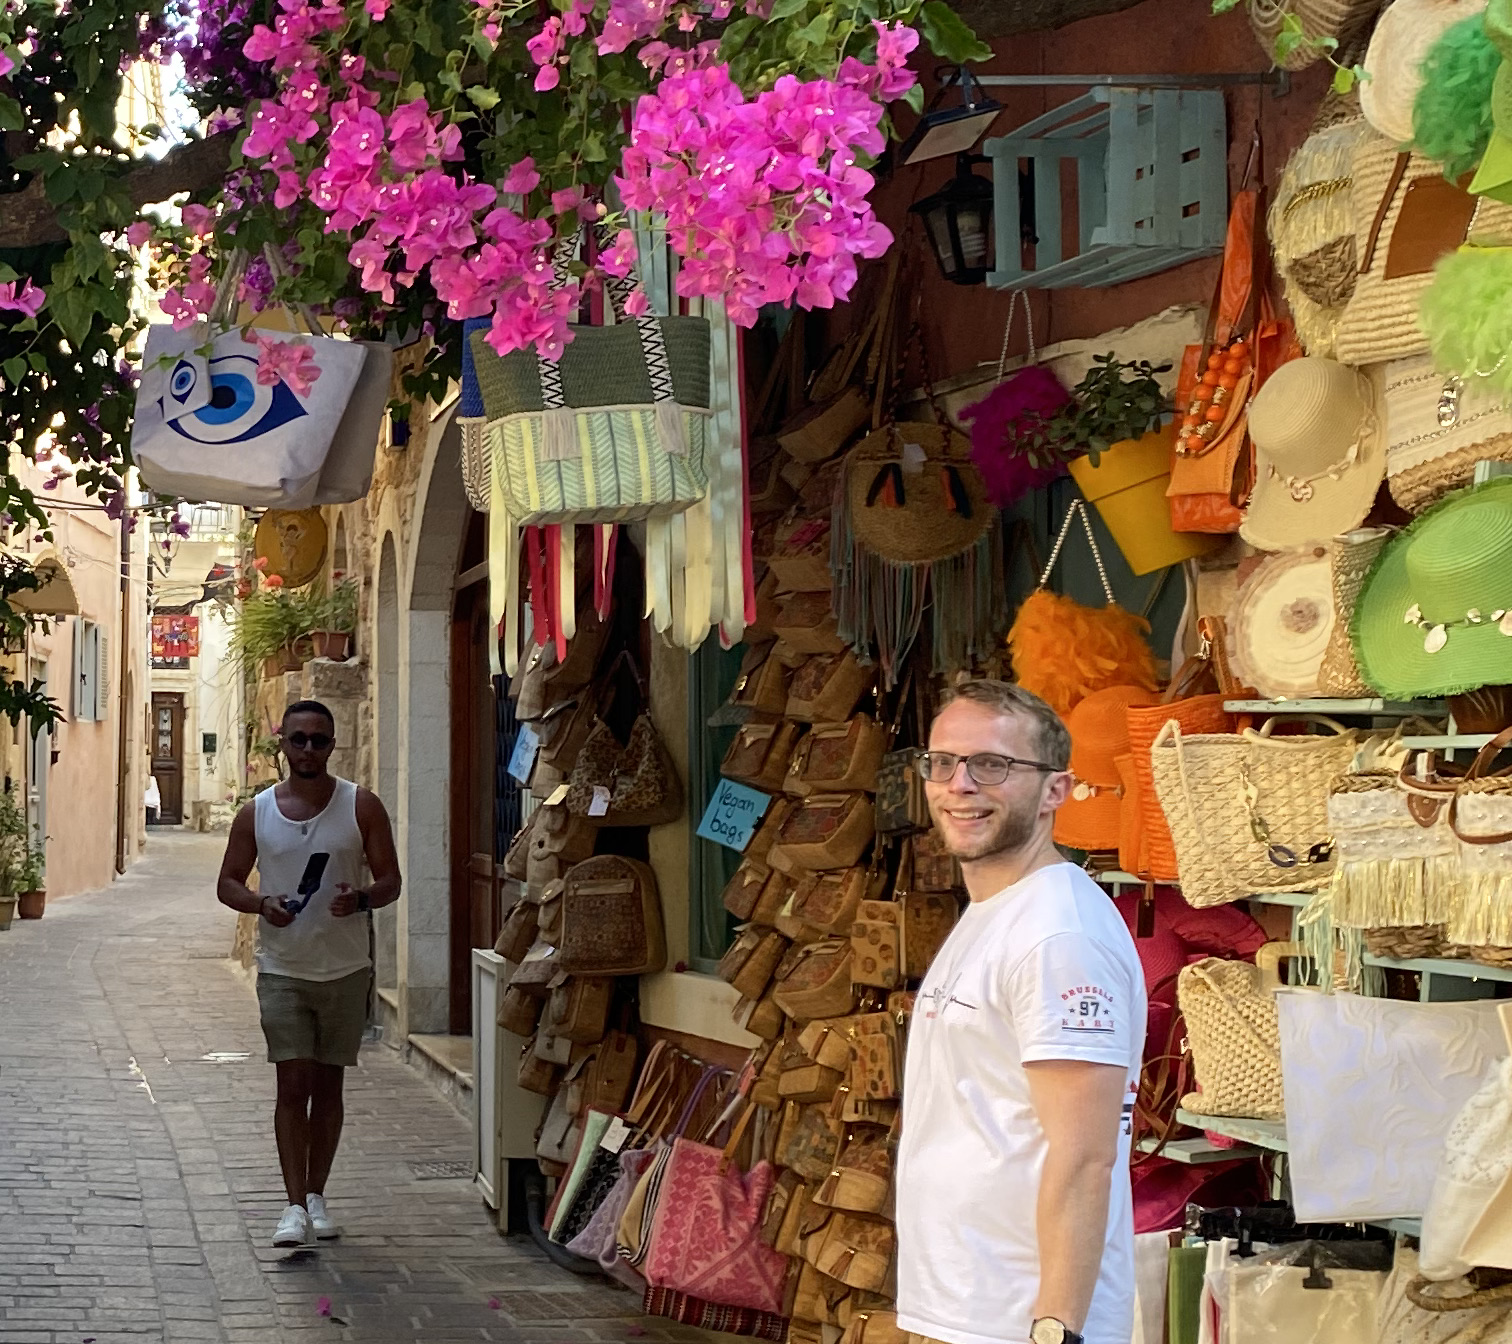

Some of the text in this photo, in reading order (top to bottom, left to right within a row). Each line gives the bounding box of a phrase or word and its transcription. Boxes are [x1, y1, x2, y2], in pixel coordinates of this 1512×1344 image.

[719, 782, 755, 819] Vegan
[710, 808, 745, 845] bags
[1080, 1001, 1100, 1017] 97
